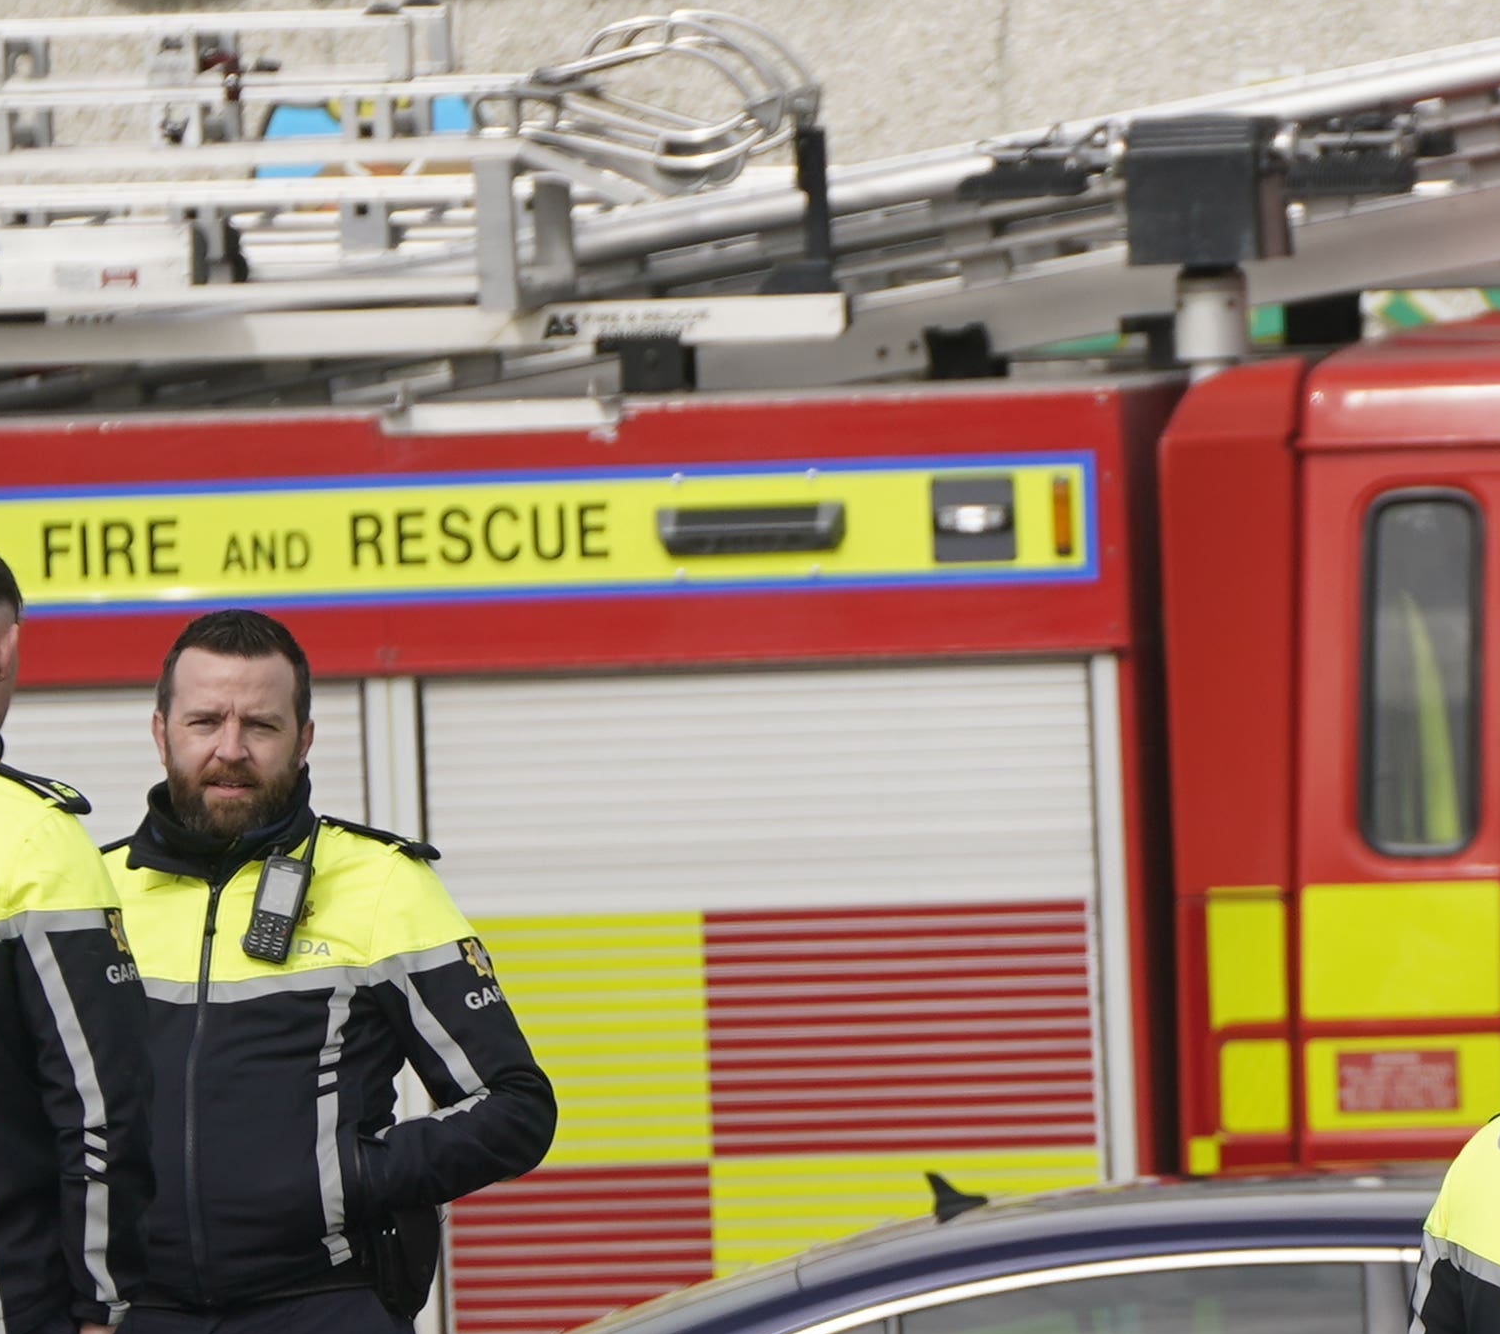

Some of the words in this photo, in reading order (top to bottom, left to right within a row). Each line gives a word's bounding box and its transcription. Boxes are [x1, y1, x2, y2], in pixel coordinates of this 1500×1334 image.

[40, 517, 180, 580] FIRE
[222, 531, 312, 572] AND
[349, 502, 611, 569] RESCUE
[106, 962, 138, 984] GAR
